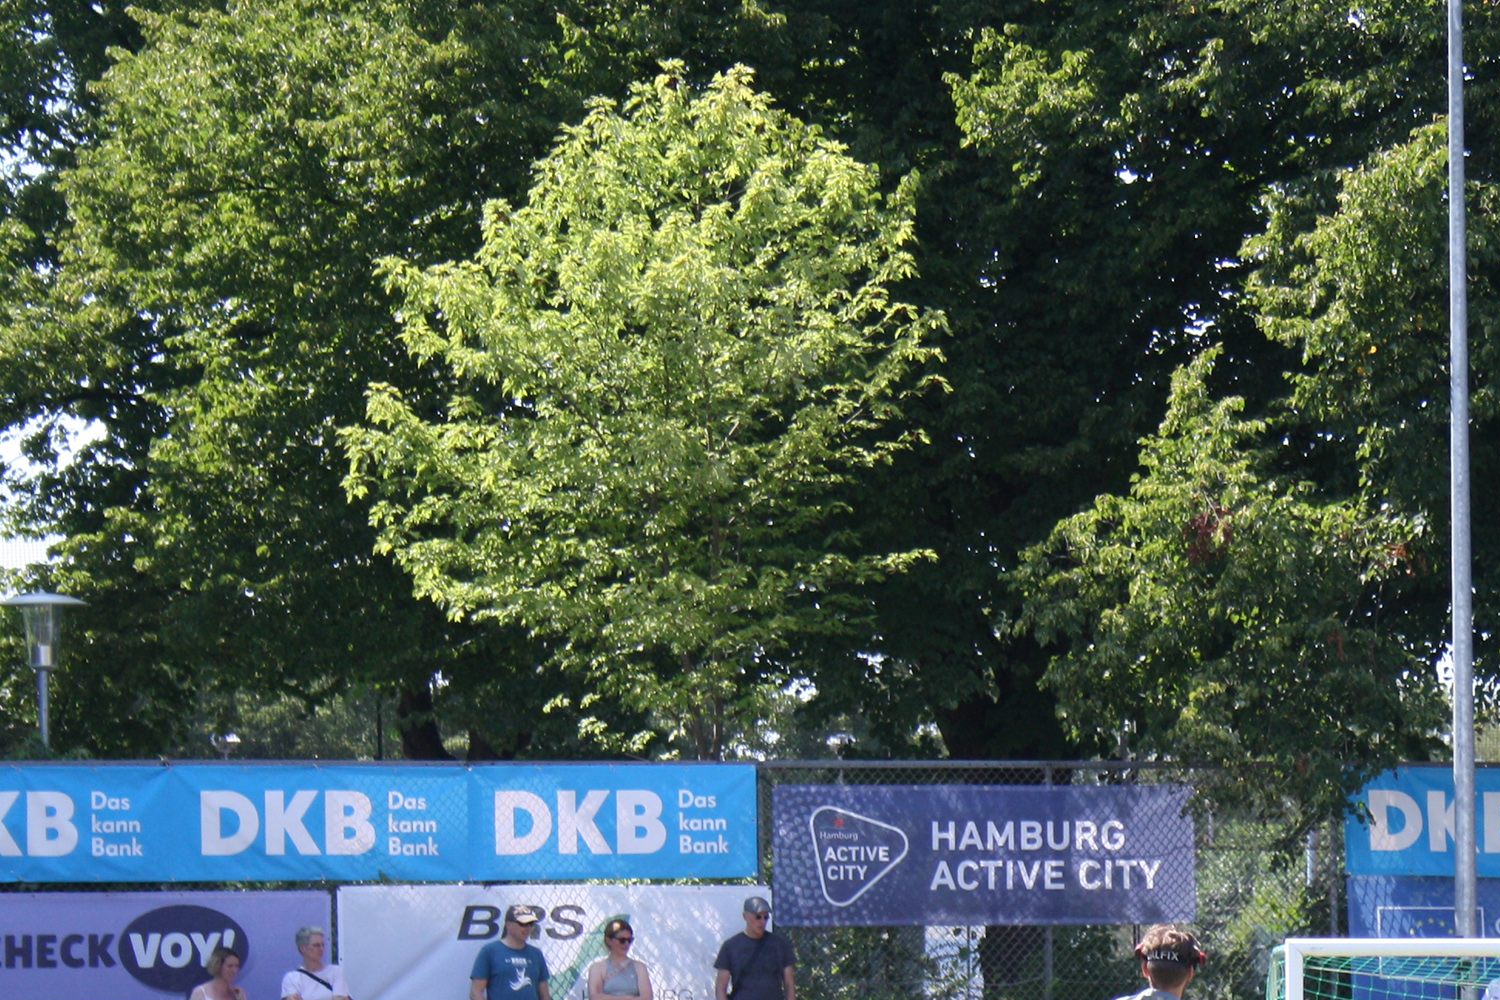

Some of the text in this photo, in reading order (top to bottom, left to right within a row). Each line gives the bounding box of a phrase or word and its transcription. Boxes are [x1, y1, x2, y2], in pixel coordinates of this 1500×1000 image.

[91, 791, 130, 810] Das
[388, 791, 427, 810] Das
[679, 789, 717, 808] Das
[91, 814, 141, 833] kann
[200, 790, 376, 855] DKB
[388, 813, 437, 833] kann
[494, 790, 667, 855] DKB
[679, 812, 727, 831] kann
[680, 835, 729, 854] Bank
[820, 831, 858, 841] Hamburg
[932, 820, 1126, 851] HAMBURG
[91, 837, 143, 857] Bank
[389, 837, 439, 856] Bank
[825, 847, 889, 861] ACTIVE
[827, 865, 867, 880] CITY
[930, 860, 1161, 891] ACTIVE CITY
[0, 929, 235, 969] HECK VOY!
